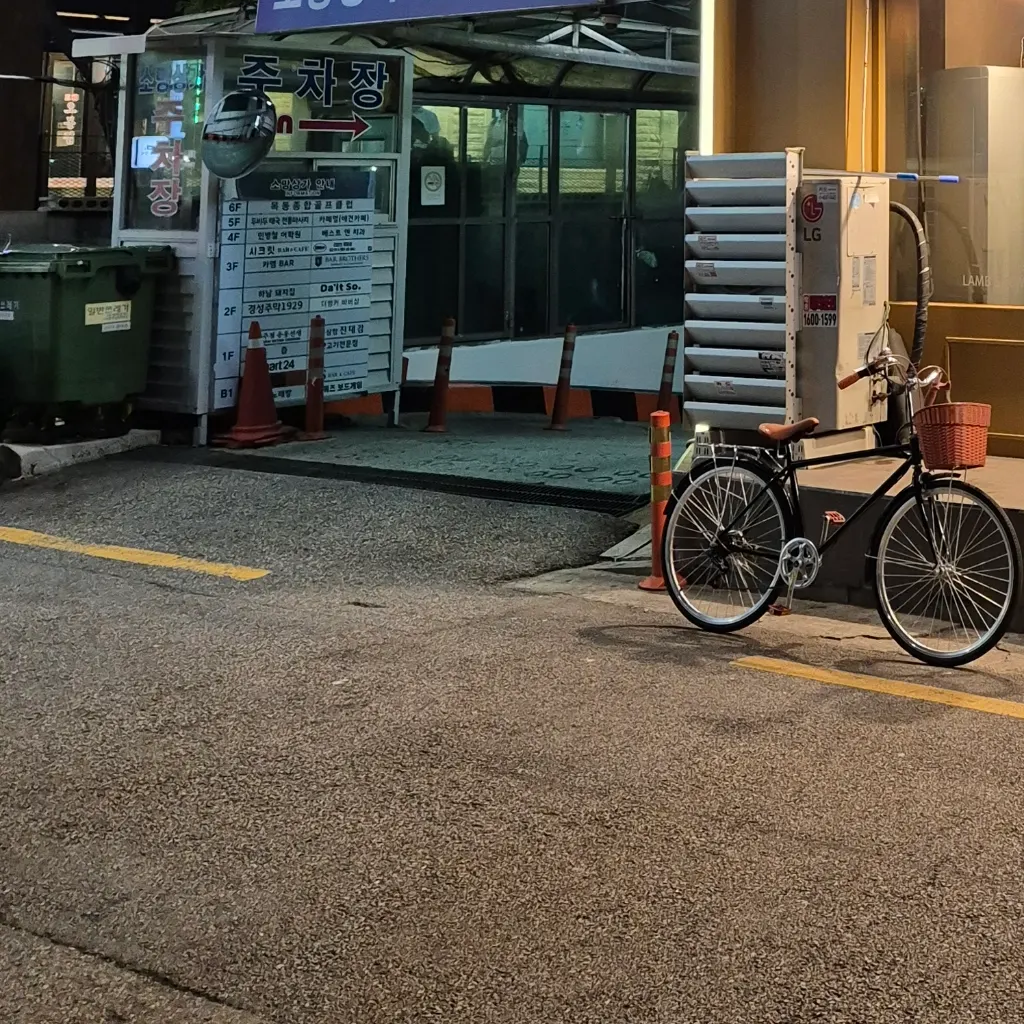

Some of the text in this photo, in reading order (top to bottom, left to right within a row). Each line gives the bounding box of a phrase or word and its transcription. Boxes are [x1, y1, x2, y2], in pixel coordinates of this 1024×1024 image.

[237, 54, 390, 110] 주차장
[270, 178, 336, 191] 소망상가 안내
[228, 204, 242, 212] 6F
[228, 217, 241, 227] 5F
[227, 232, 240, 241] 4F
[803, 228, 822, 241] LG
[249, 246, 275, 256] 시크릿
[226, 262, 239, 271] 3F
[279, 259, 294, 267] BAR
[962, 275, 990, 287] LAMB
[224, 302, 303, 316] 2F 경성주막1929
[803, 313, 837, 325] 1600-1599
[325, 339, 358, 349] 고기전문점
[222, 351, 234, 361] 1F
[220, 388, 233, 398] B1
